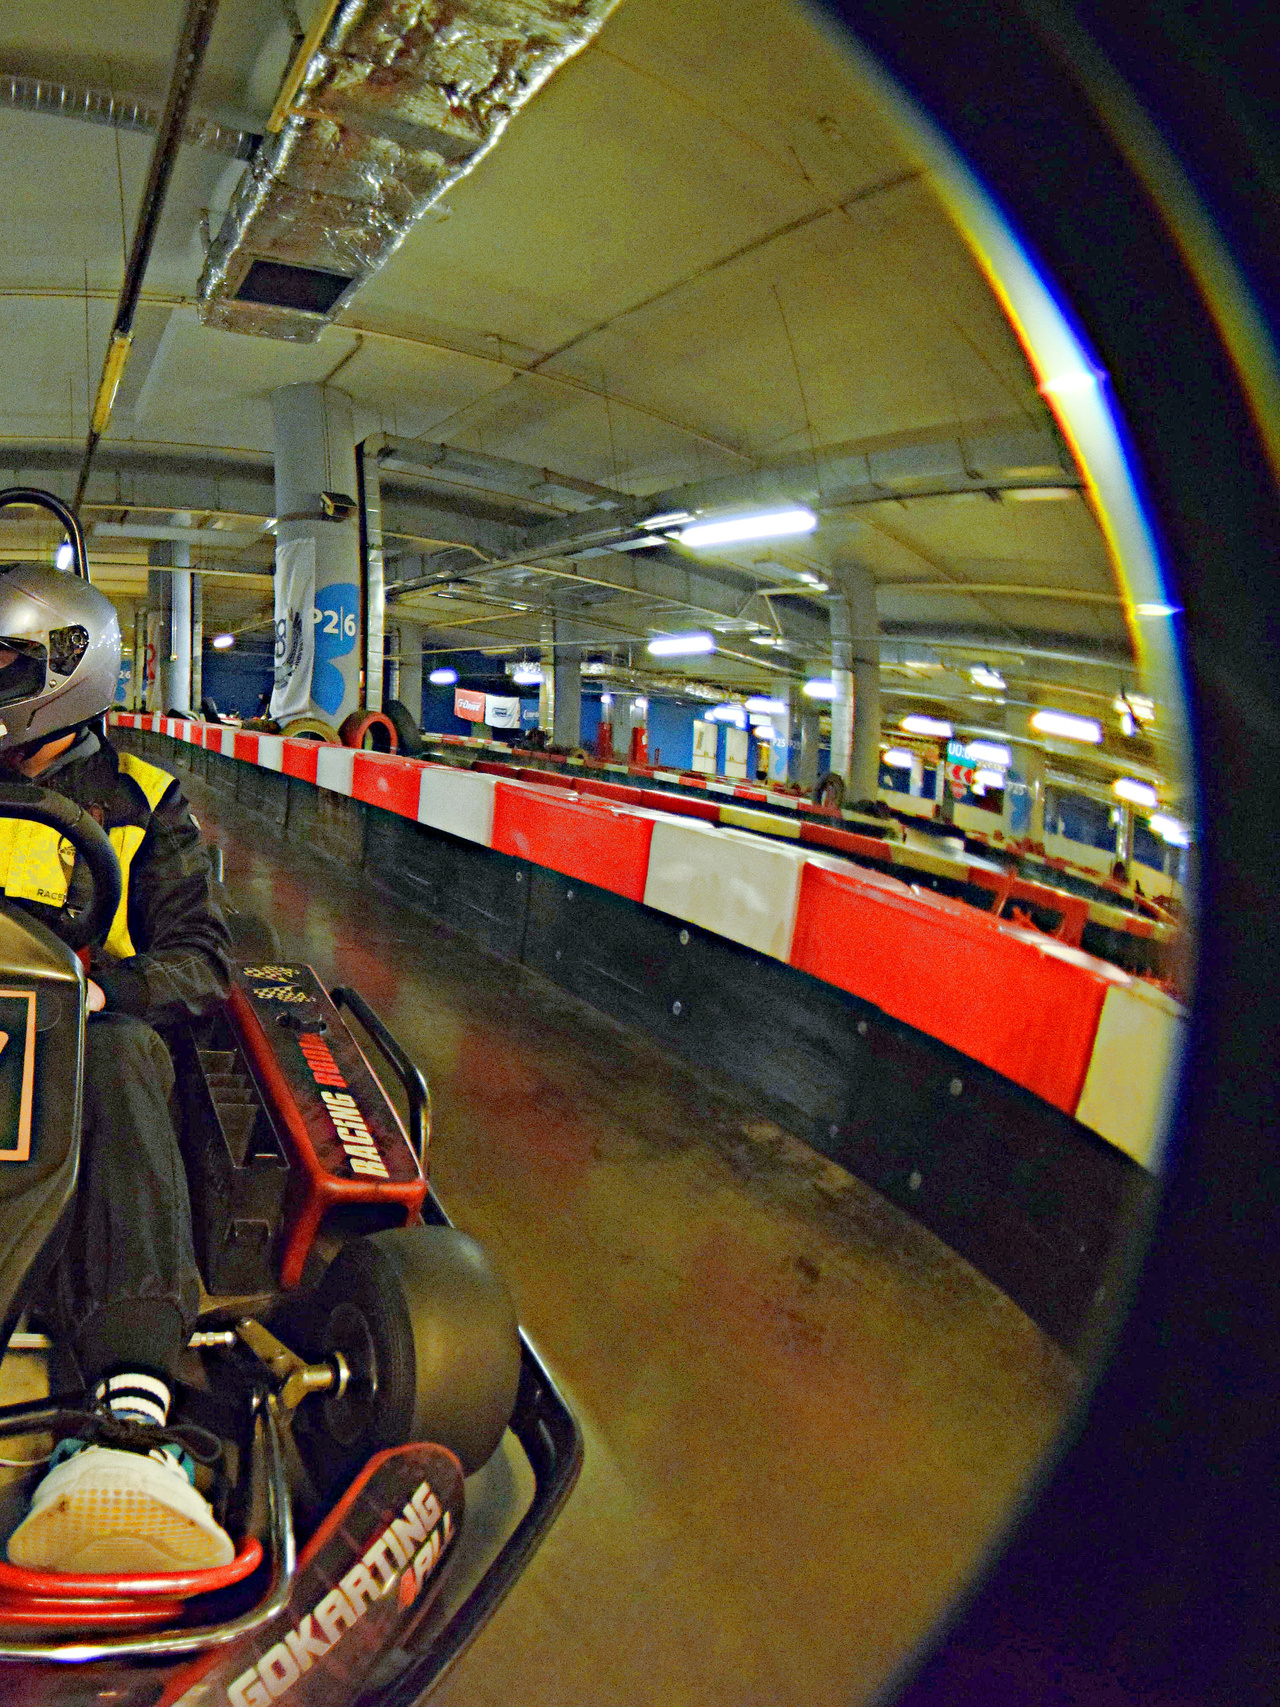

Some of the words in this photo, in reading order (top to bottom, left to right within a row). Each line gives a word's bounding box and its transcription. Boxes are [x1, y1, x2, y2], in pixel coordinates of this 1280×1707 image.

[37, 888, 66, 902] RACE
[321, 1090, 390, 1178] RACING
[227, 1481, 442, 1707] GOKARTING
